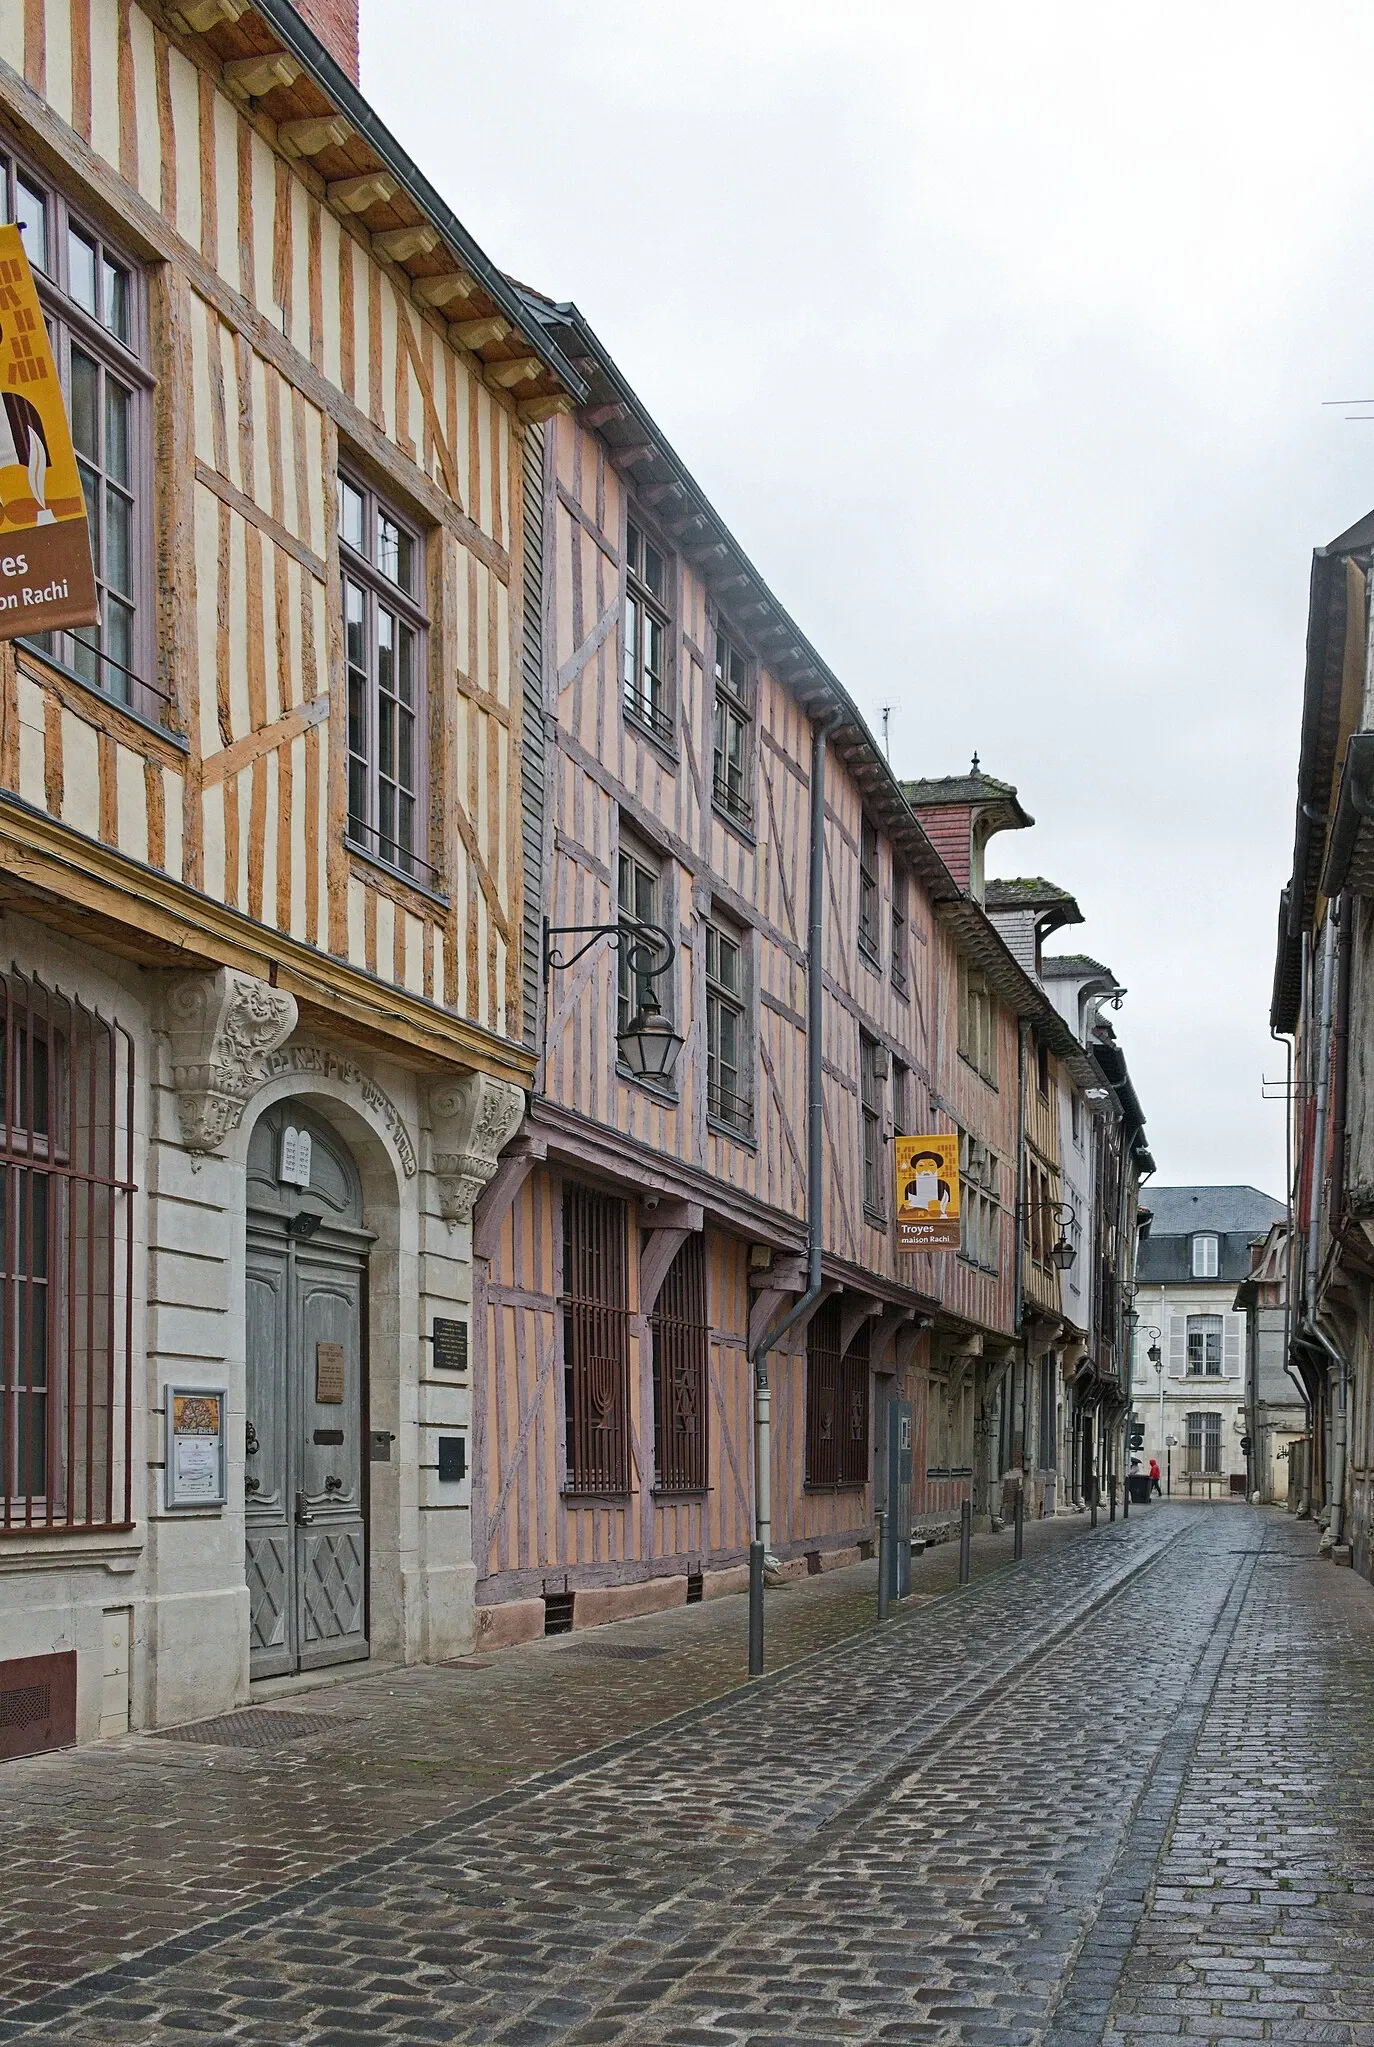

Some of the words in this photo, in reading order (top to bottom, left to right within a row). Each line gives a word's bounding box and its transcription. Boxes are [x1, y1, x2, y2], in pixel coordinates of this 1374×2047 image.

[22, 578, 69, 606] Rachi
[901, 1225, 934, 1236] Troyes
[901, 1236, 929, 1244] maison
[930, 1235, 950, 1243] Rachi
